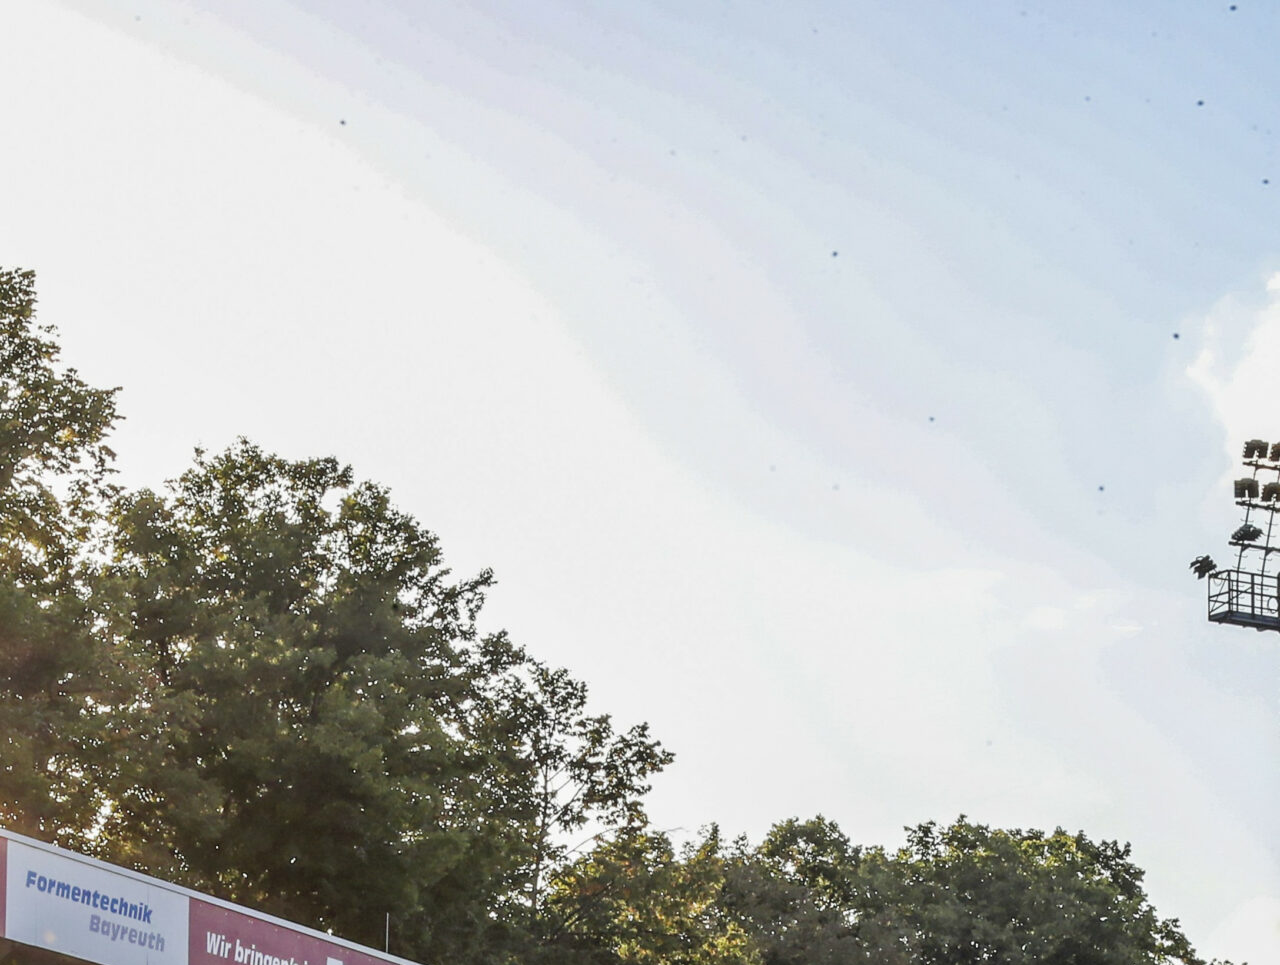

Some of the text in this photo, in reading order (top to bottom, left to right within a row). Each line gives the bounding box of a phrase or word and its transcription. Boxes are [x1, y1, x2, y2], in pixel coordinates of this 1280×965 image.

[25, 870, 153, 924] Formentechnik
[89, 915, 166, 953] Bayreuth
[206, 931, 233, 960] Wir
